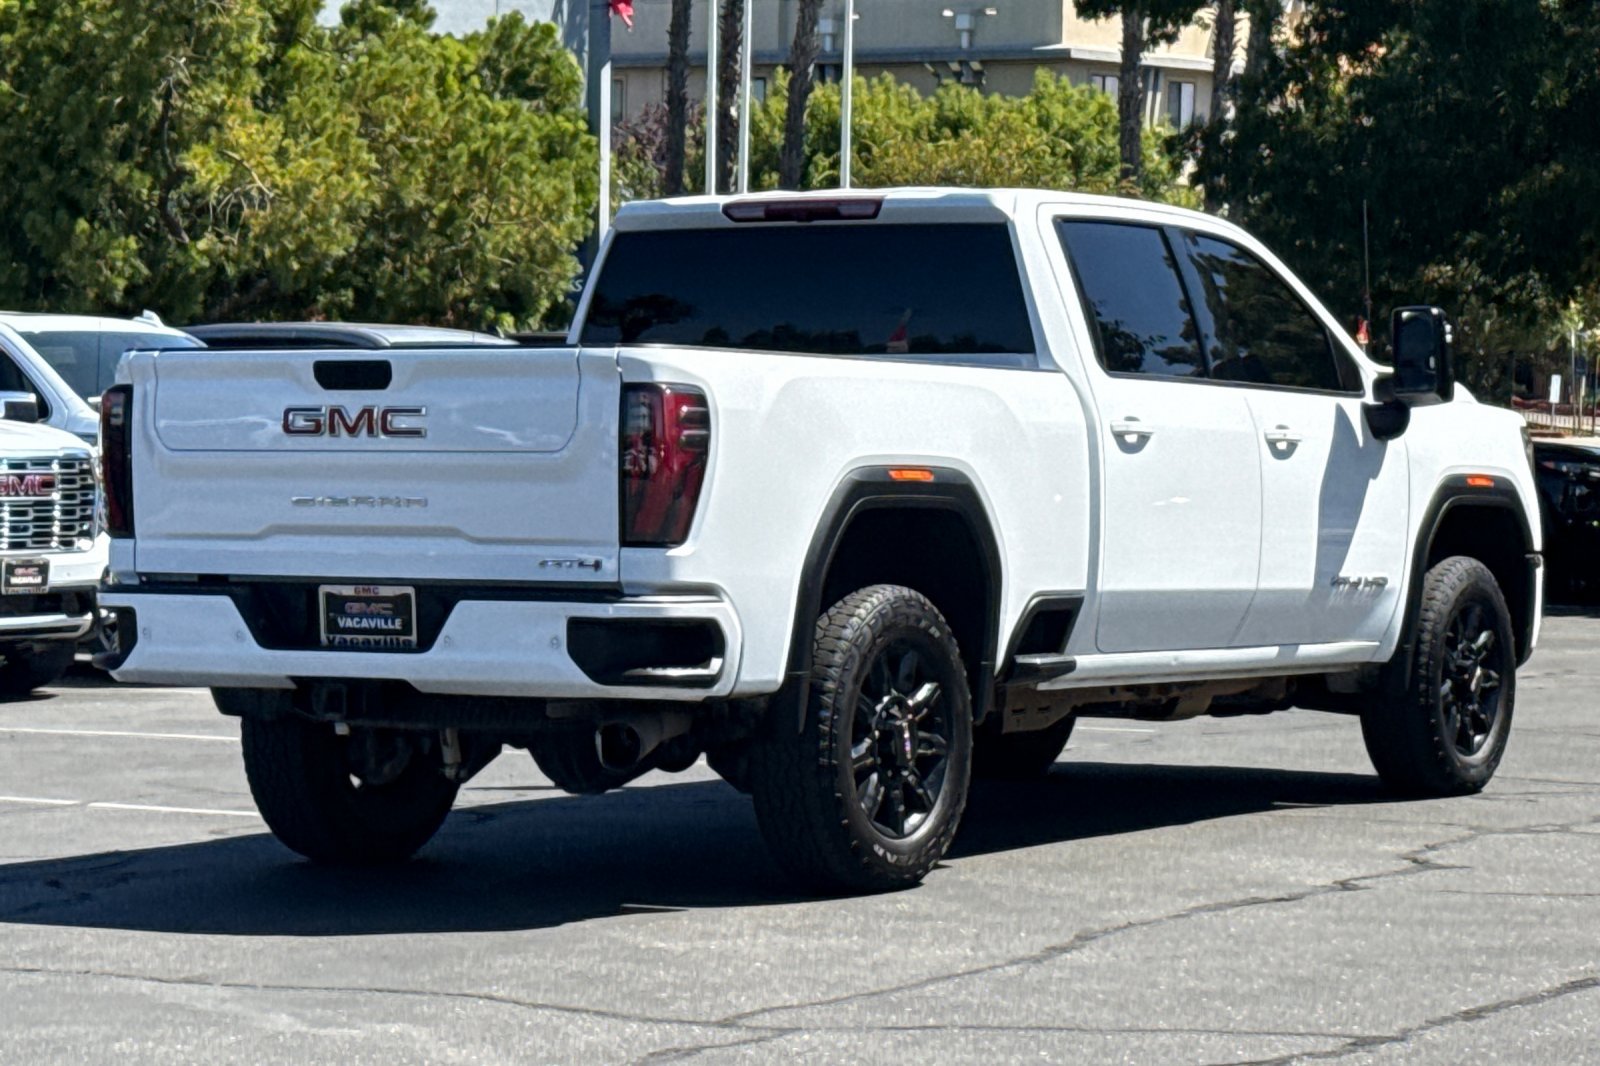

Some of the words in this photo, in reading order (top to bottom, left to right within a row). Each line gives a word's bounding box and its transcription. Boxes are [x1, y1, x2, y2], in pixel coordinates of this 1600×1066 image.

[282, 405, 428, 438] GMC
[354, 586, 380, 595] GMC
[337, 616, 403, 630] VACAVILLE
